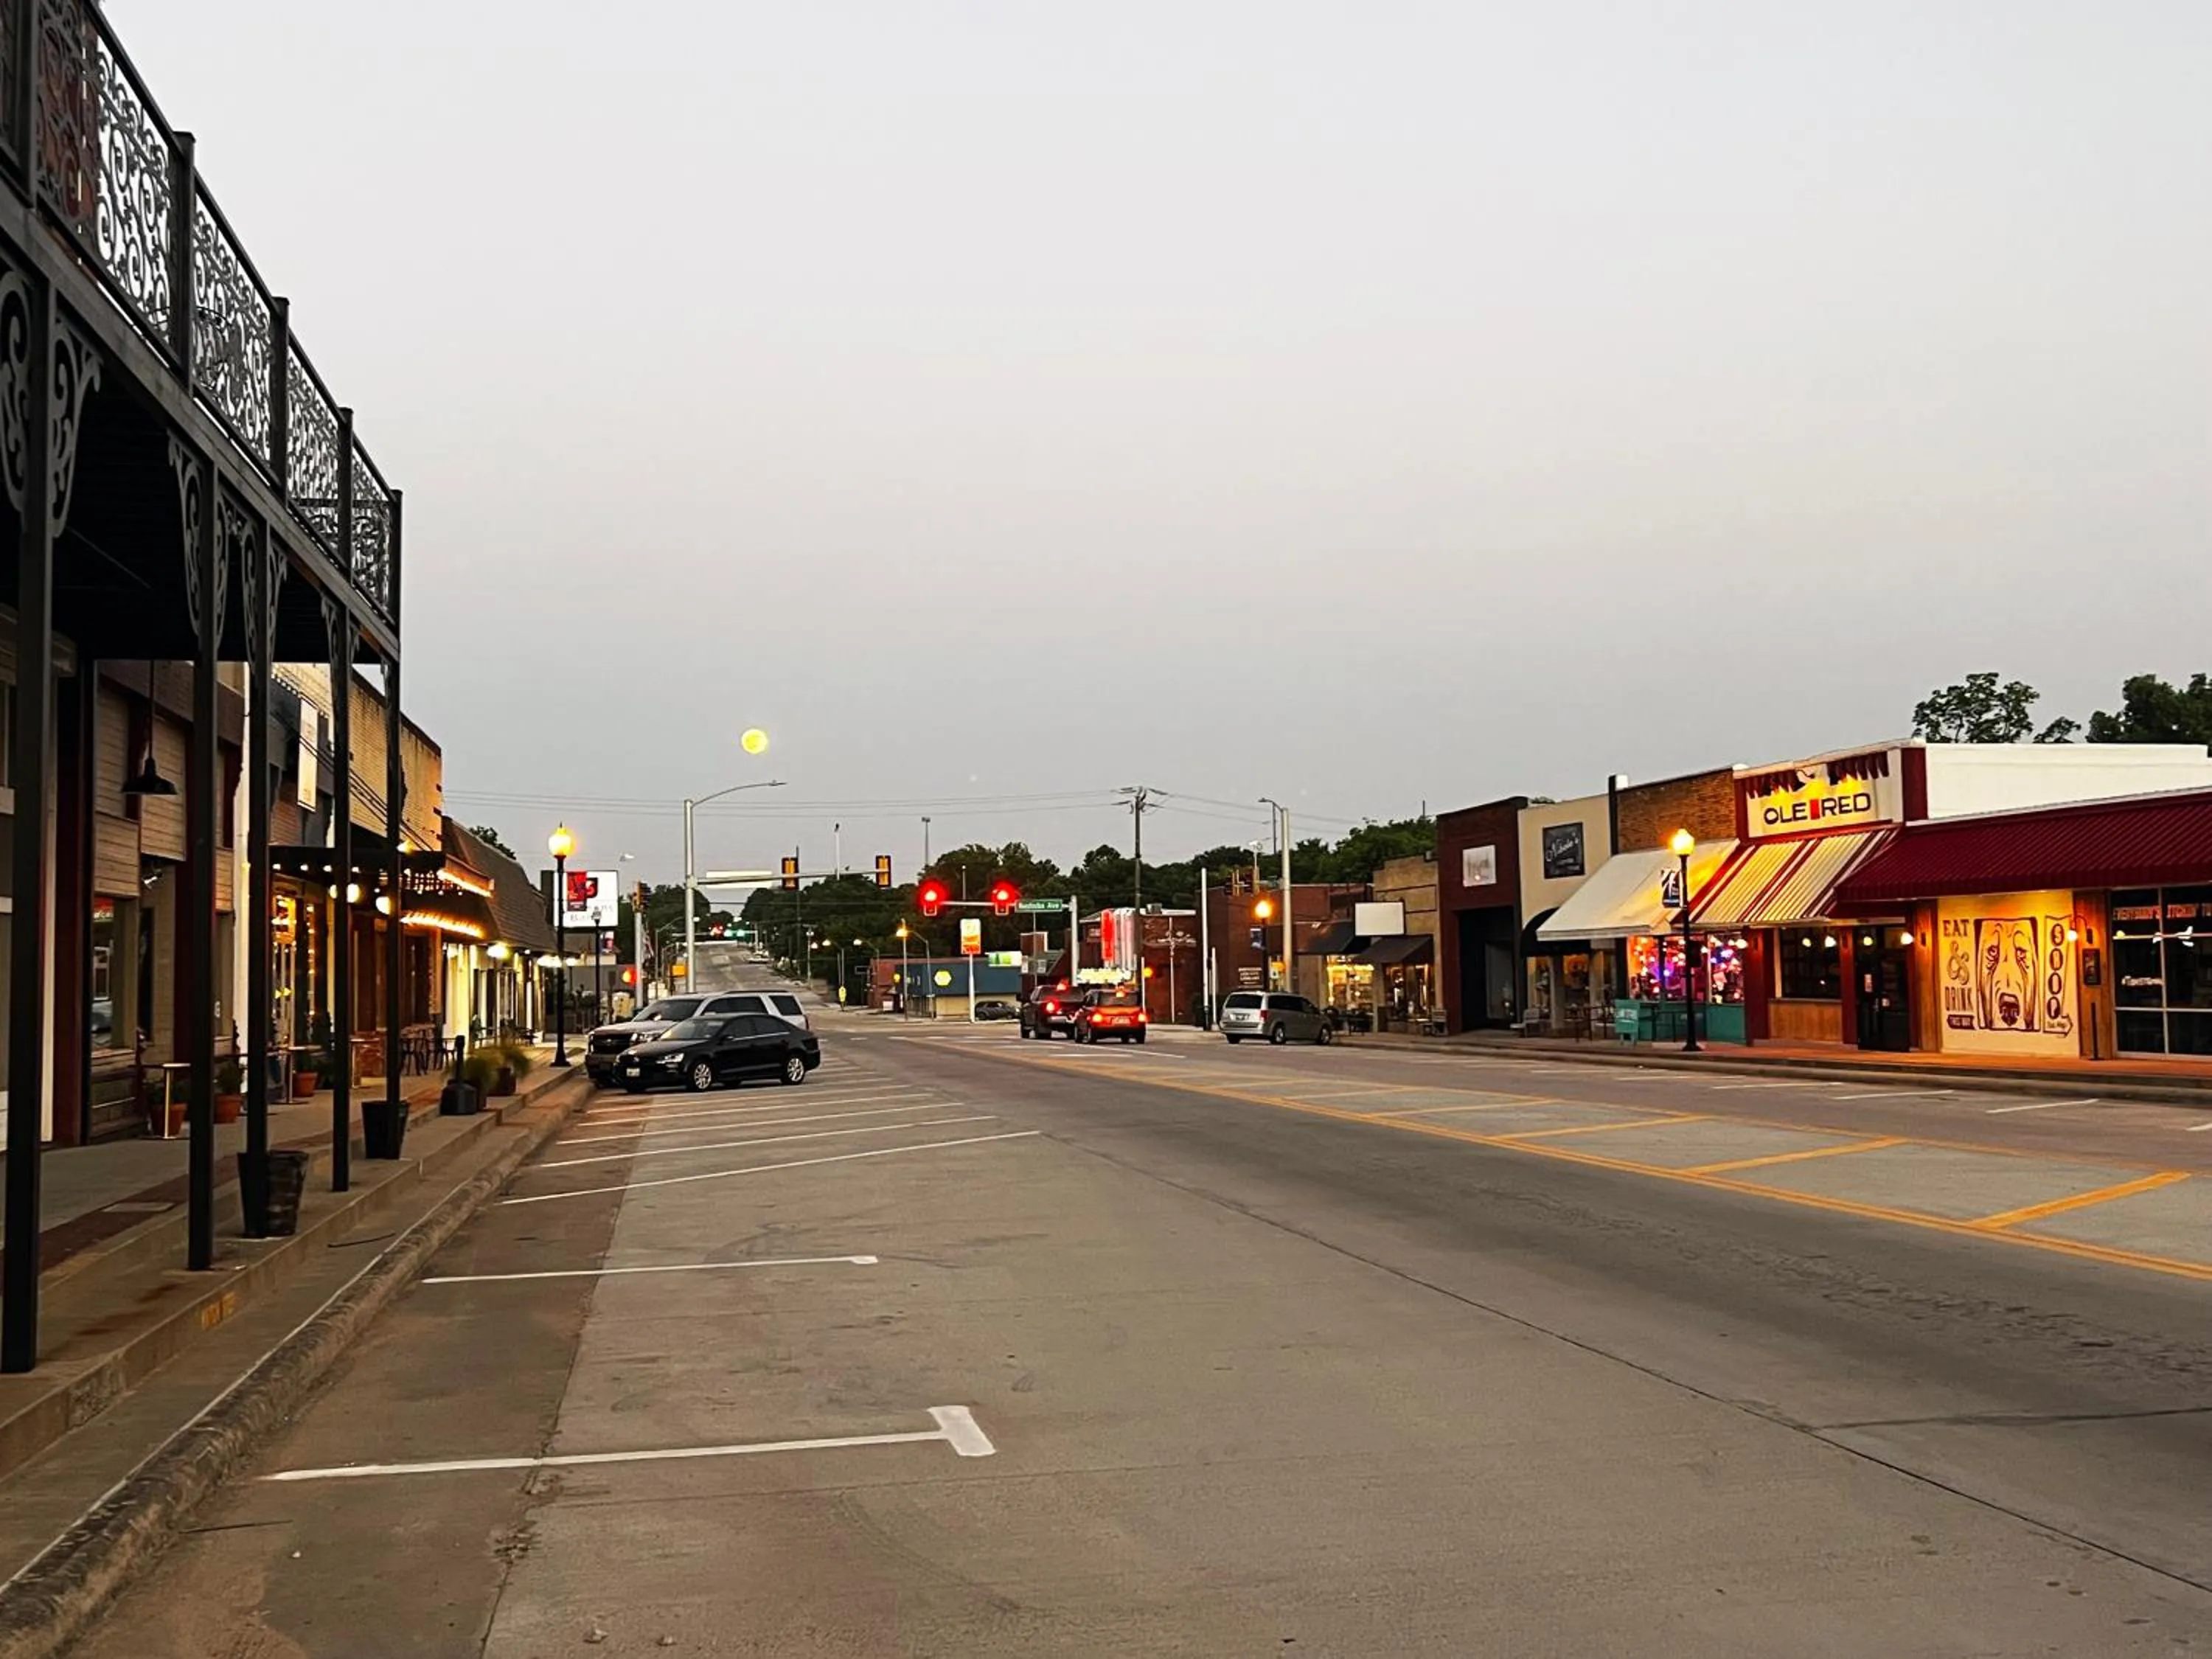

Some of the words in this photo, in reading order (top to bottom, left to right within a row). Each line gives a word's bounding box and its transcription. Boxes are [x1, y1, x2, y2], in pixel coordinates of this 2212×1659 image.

[1763, 802, 1808, 825] OLE
[1820, 793, 1871, 817] RED
[1943, 919, 1969, 937] EAT
[1947, 940, 1970, 986] &
[1944, 986, 1974, 1012] DRINK
